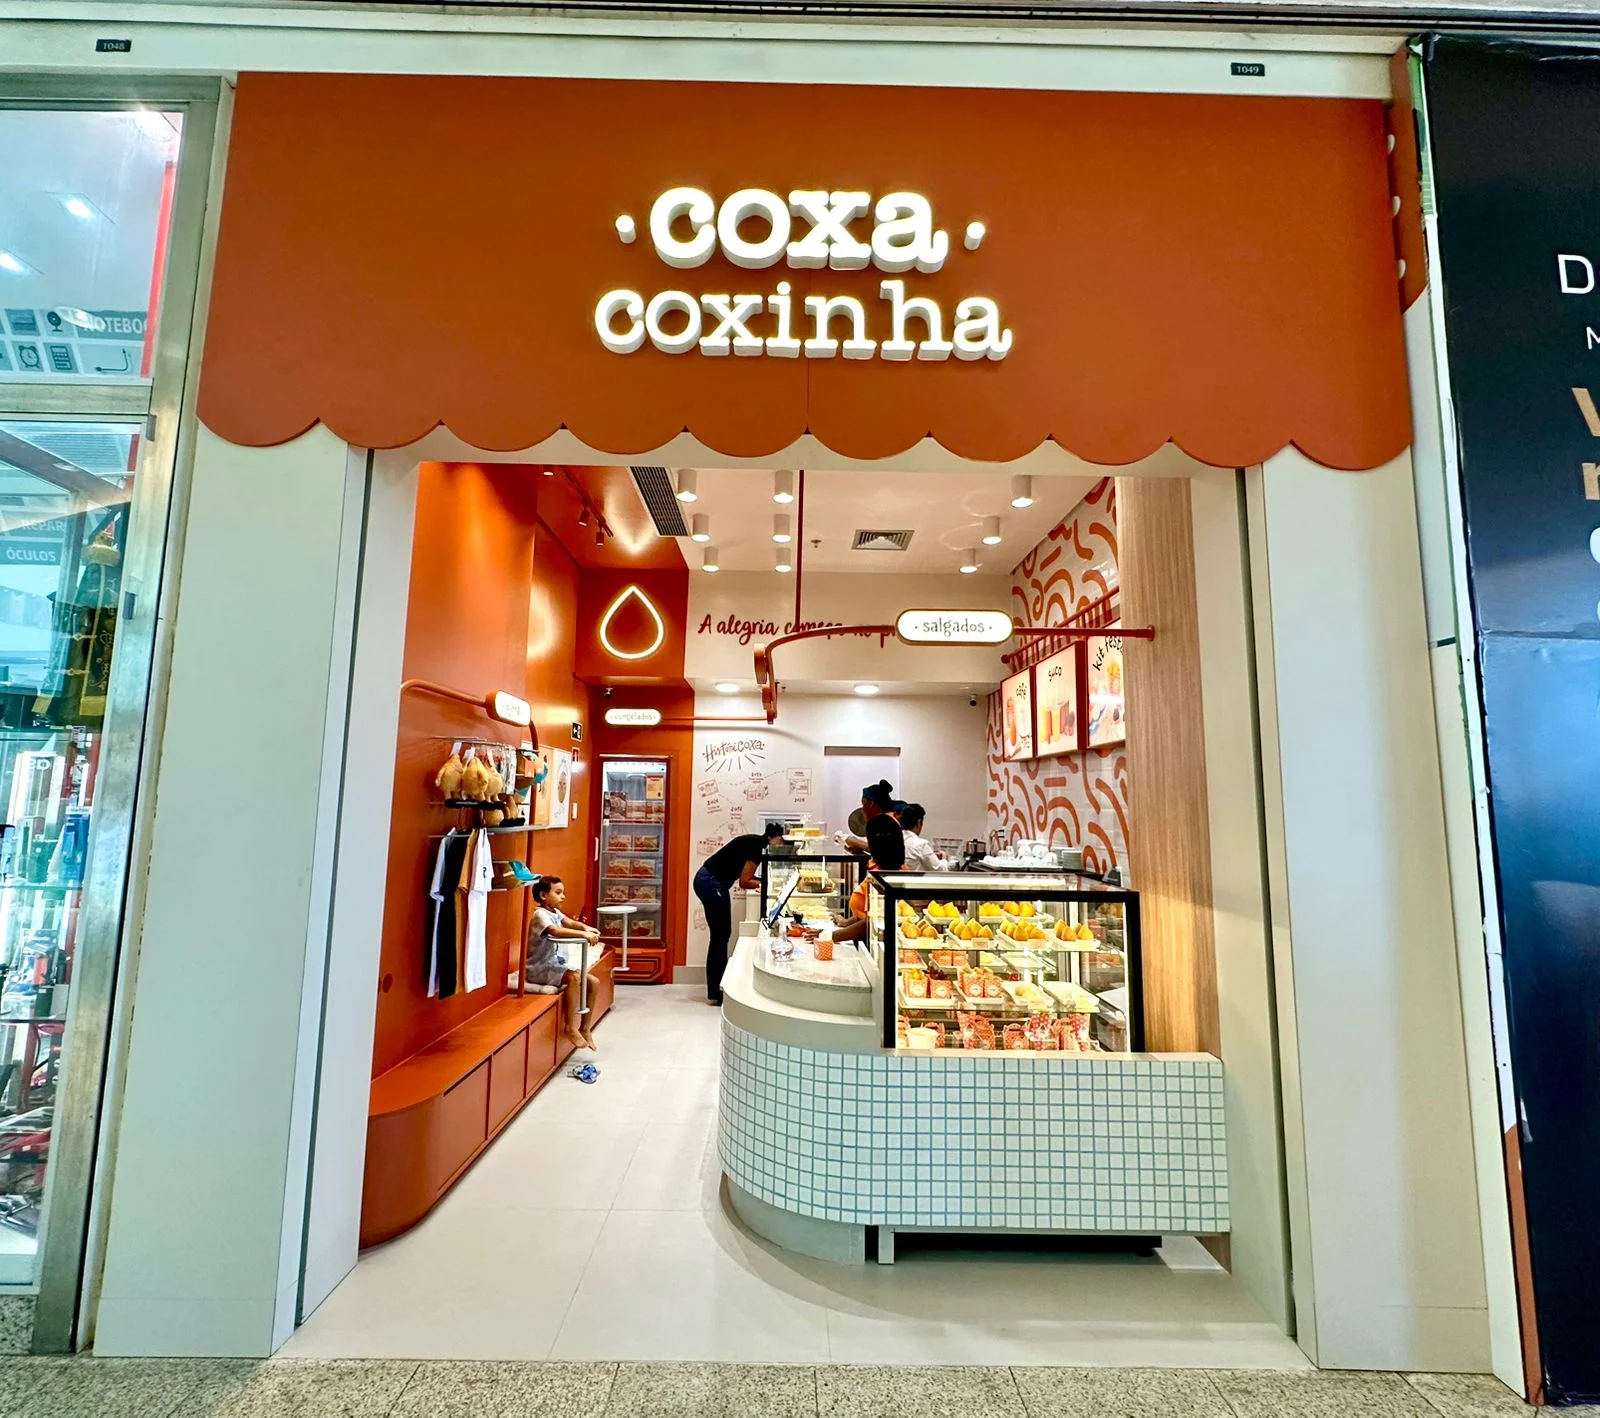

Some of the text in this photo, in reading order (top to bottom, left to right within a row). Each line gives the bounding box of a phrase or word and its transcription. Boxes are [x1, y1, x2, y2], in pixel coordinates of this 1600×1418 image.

[1236, 65, 1259, 74] 1049
[650, 186, 949, 273] coxa
[83, 316, 148, 334] NOTEBO
[595, 279, 1013, 361] coxinha
[6, 546, 56, 562] ÓCULOS
[698, 613, 711, 634] A
[717, 613, 779, 646] alegria
[922, 617, 985, 637] salgados
